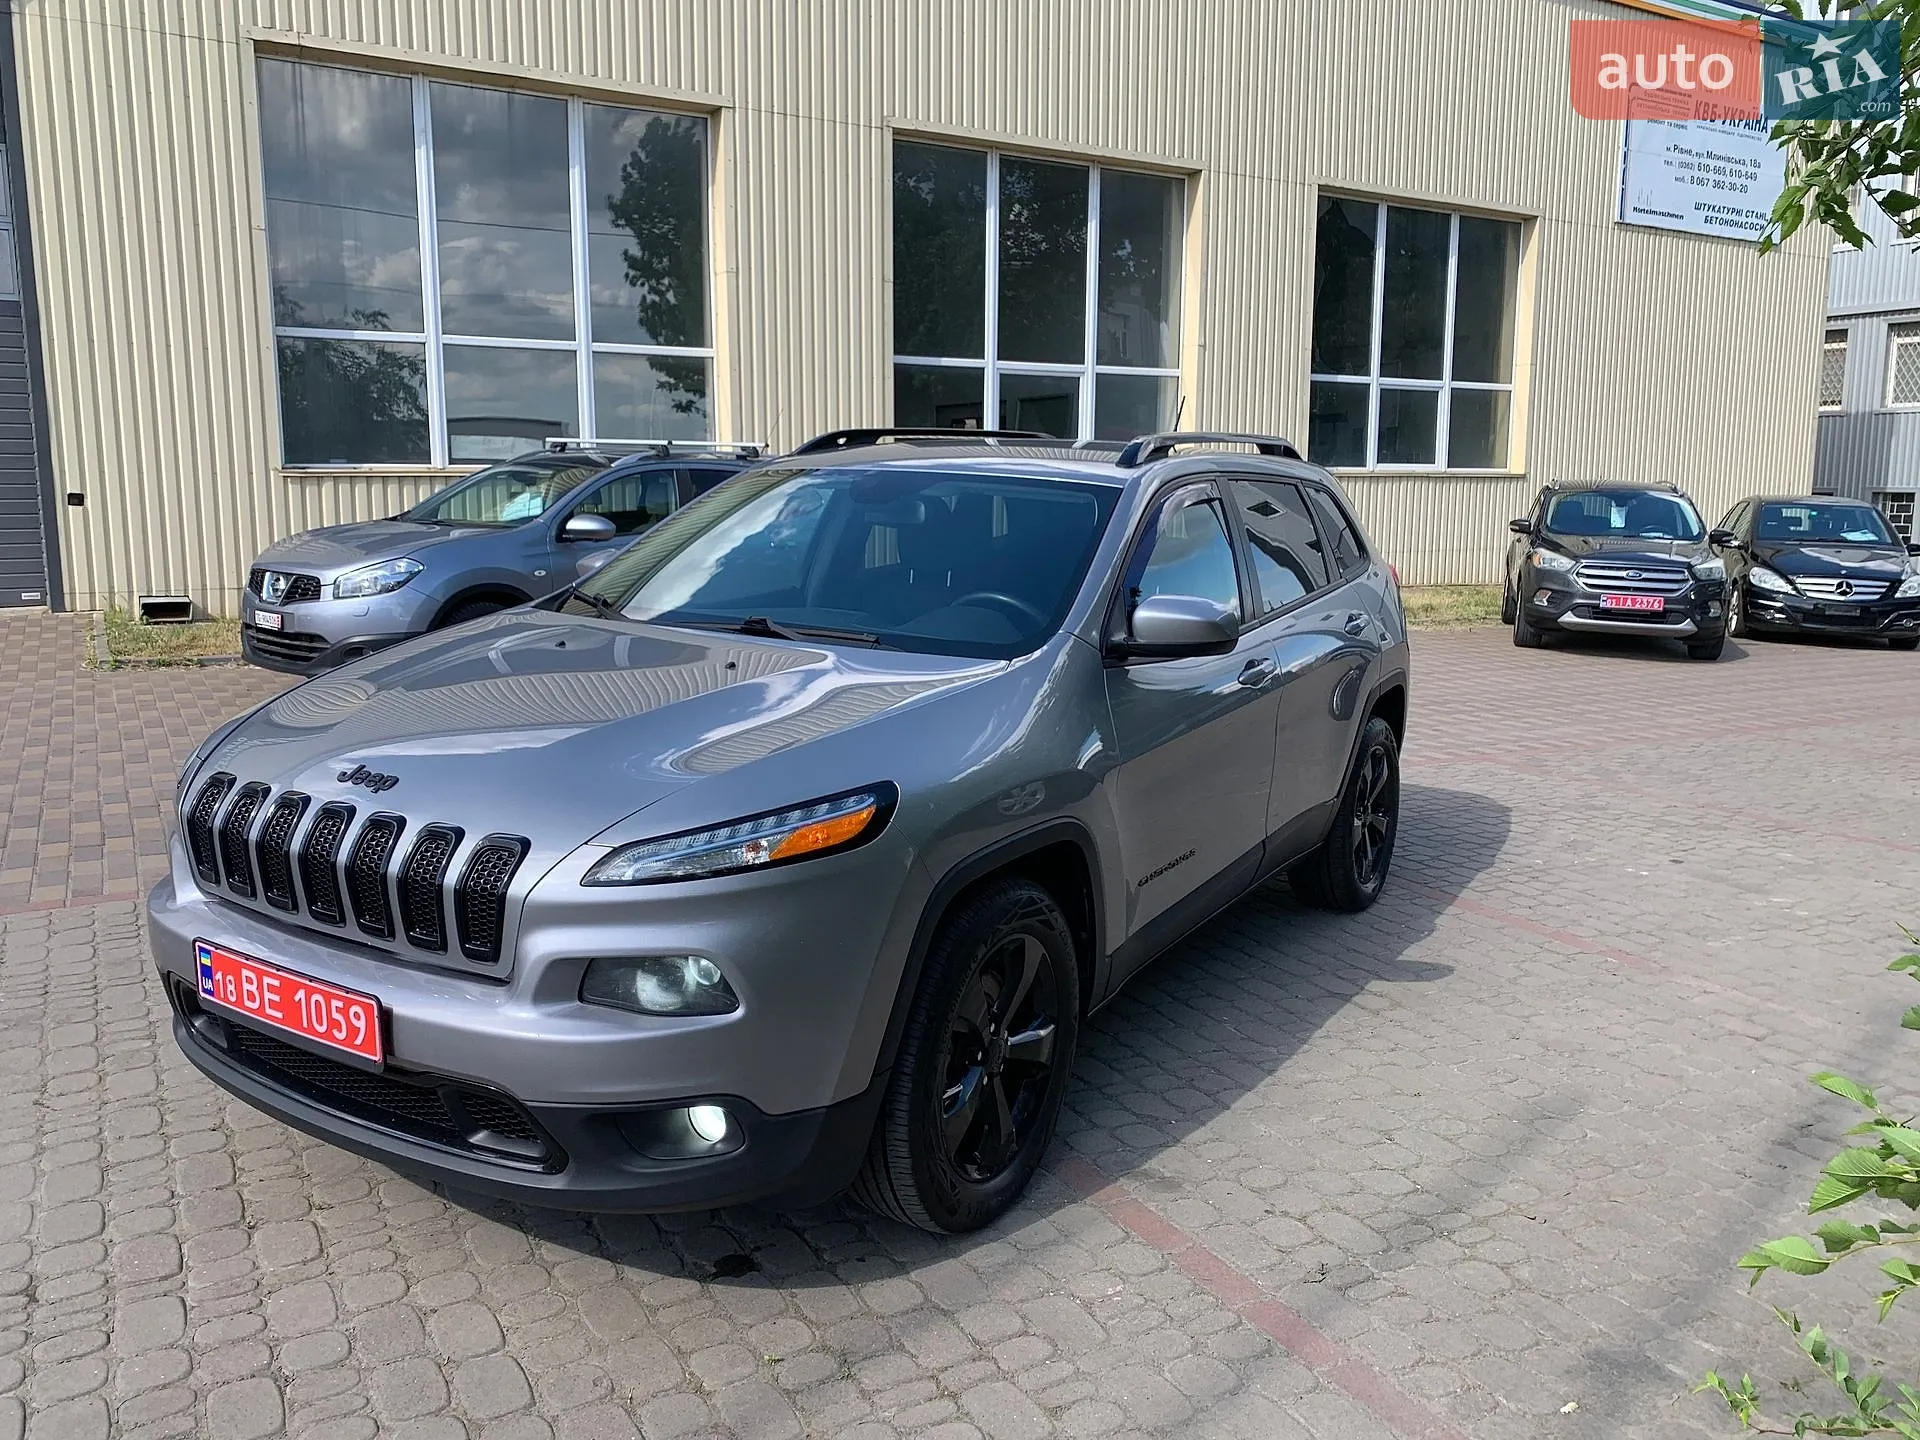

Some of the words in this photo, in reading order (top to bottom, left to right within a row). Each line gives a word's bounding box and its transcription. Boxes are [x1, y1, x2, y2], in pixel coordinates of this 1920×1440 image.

[1693, 99, 1768, 134] КВБ-УКРАЇНА
[1673, 144, 1695, 158] Рівне,
[1706, 150, 1748, 168] Млинівська,
[1749, 158, 1762, 169] 18а
[1729, 168, 1758, 182] 610-649
[1695, 176, 1710, 187] 067
[1712, 179, 1749, 194] 362-30-20
[1694, 201, 1744, 217] ШТУКАТУРНІ
[1636, 598, 1660, 609] 2376
[336, 764, 400, 794] Jeep
[202, 976, 214, 992] UA
[215, 970, 237, 1003] 18
[241, 967, 284, 1020] BE
[293, 988, 367, 1046] 1059
